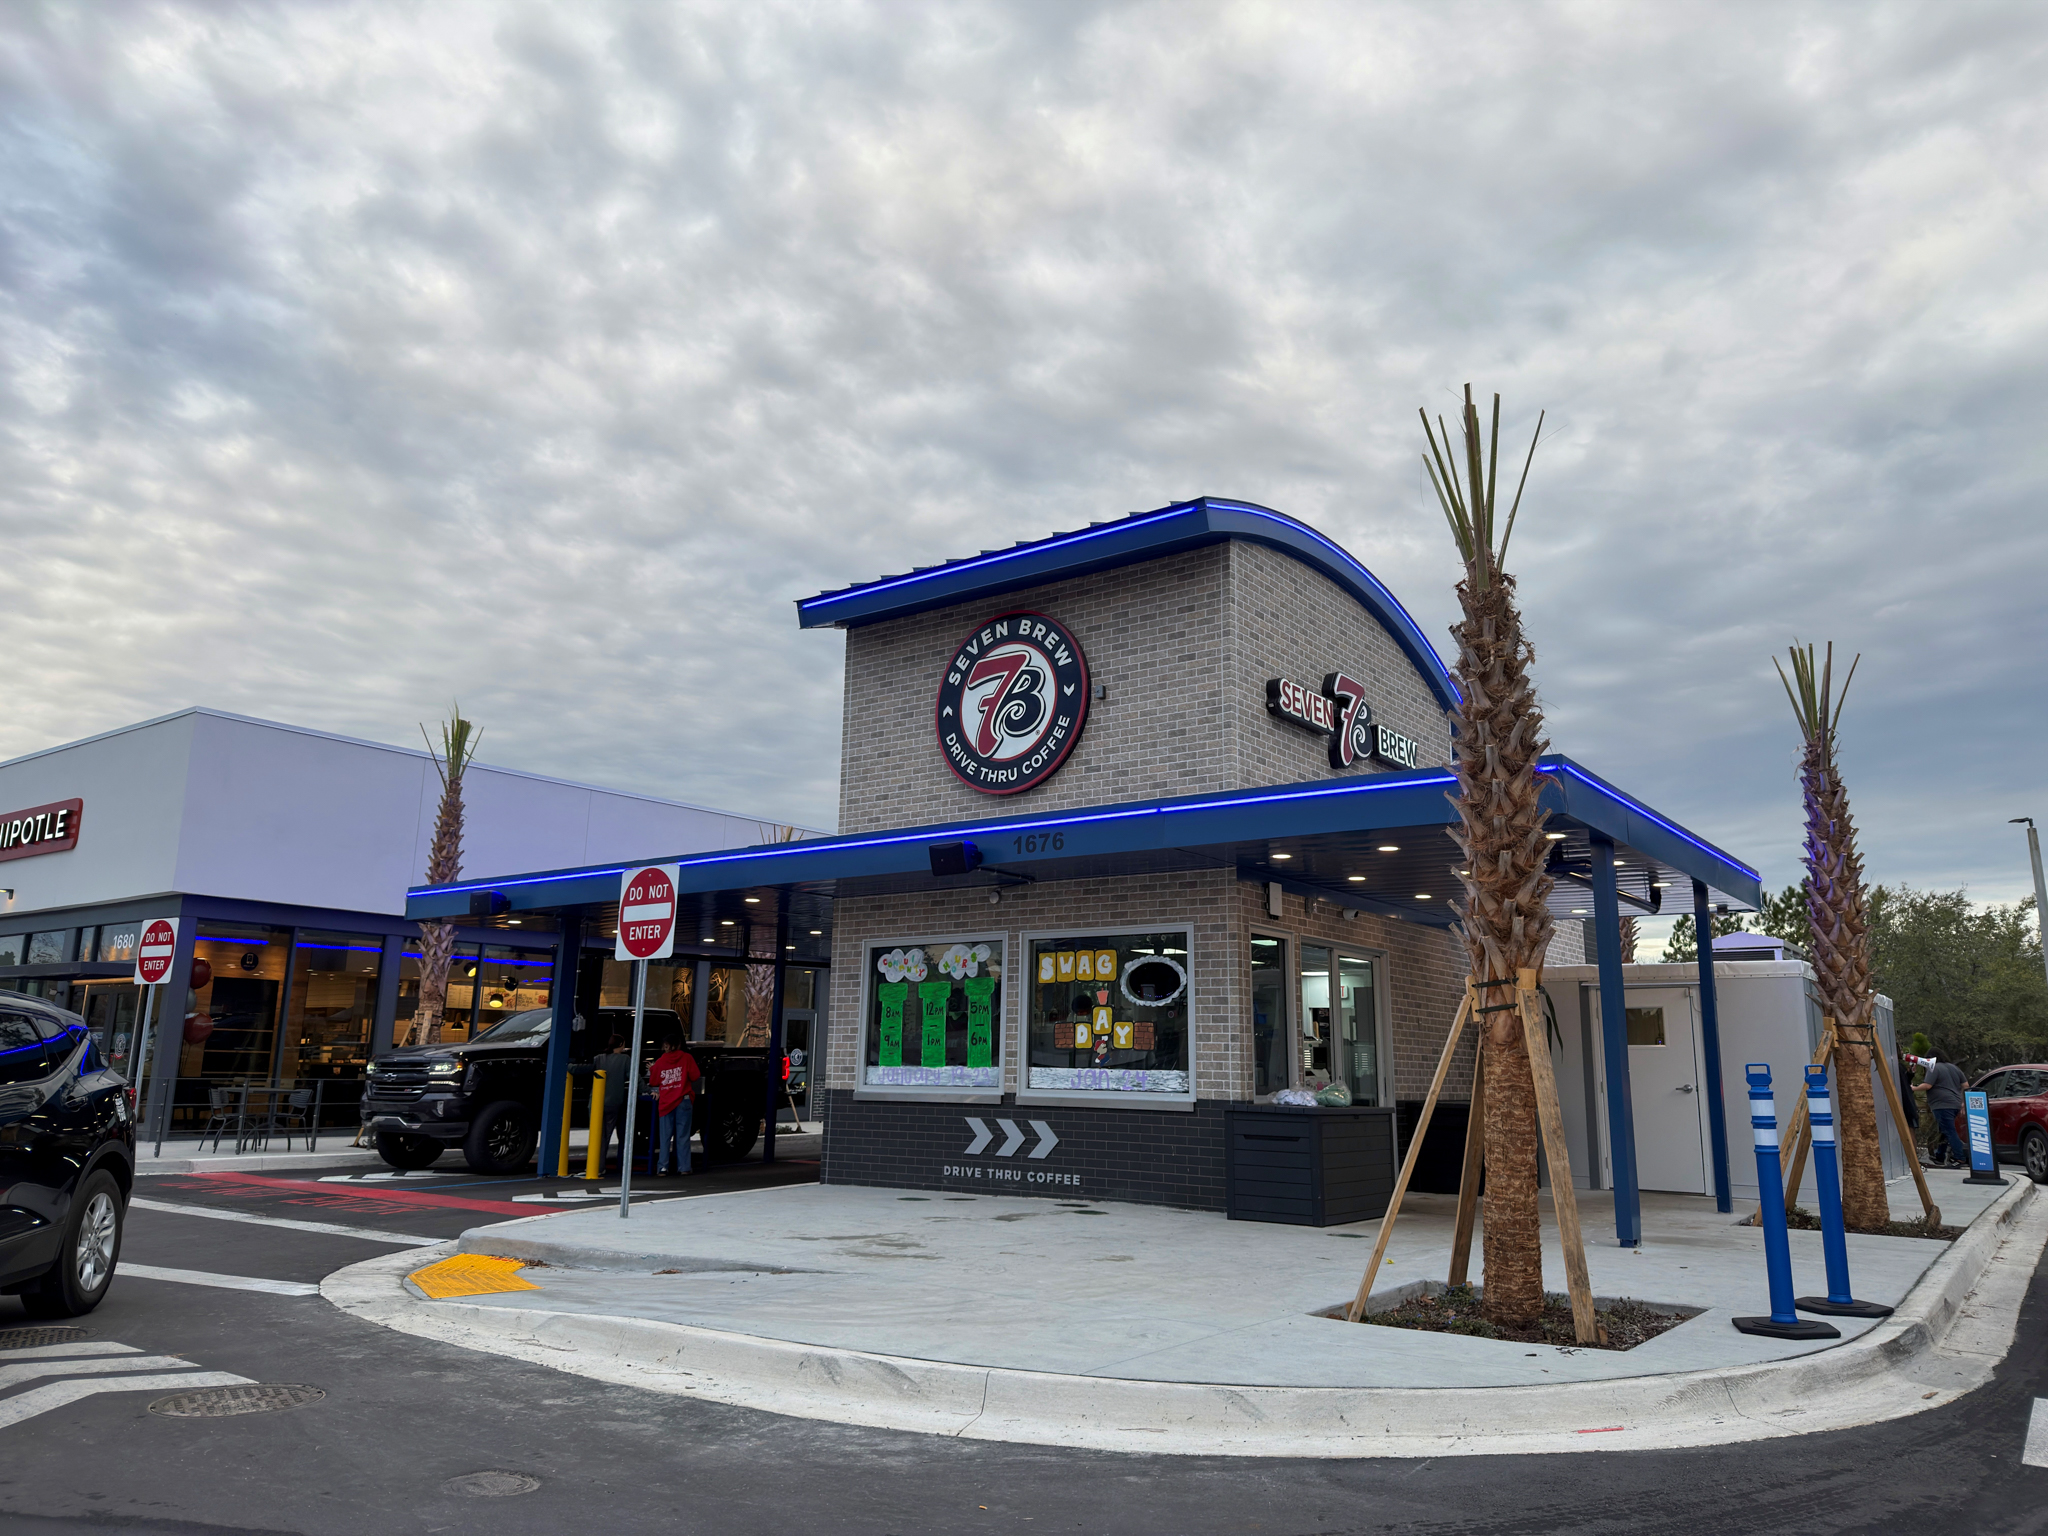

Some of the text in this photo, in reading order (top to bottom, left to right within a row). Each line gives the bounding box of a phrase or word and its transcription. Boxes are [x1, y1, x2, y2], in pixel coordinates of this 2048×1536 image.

[948, 619, 1073, 686] SEVEN BREW
[1280, 678, 1335, 732] SEVEN
[1378, 724, 1418, 769] BREW
[945, 715, 1071, 783] DRIVE THRU COFFEE
[1013, 832, 1064, 854] 1676
[629, 884, 669, 901] DO NOT
[113, 933, 135, 949] 1680
[145, 931, 172, 943] DO NOT
[629, 925, 661, 940] ENTER
[143, 960, 165, 971] ENTER
[943, 952, 977, 973] HOURS
[1040, 954, 1112, 980] SWAG
[885, 1007, 900, 1018] 8AM
[926, 1002, 944, 1016] 12PM
[970, 1002, 989, 1015] 5PM
[1077, 1010, 1130, 1044] DAY
[884, 1035, 900, 1047] 9AM
[927, 1034, 941, 1046] 1PM
[970, 1032, 987, 1046] 6PM
[1070, 1069, 1148, 1091] Jan 24
[1969, 1114, 1990, 1155] MENU
[943, 1165, 1081, 1185] DRIVE THRU COFFEE
